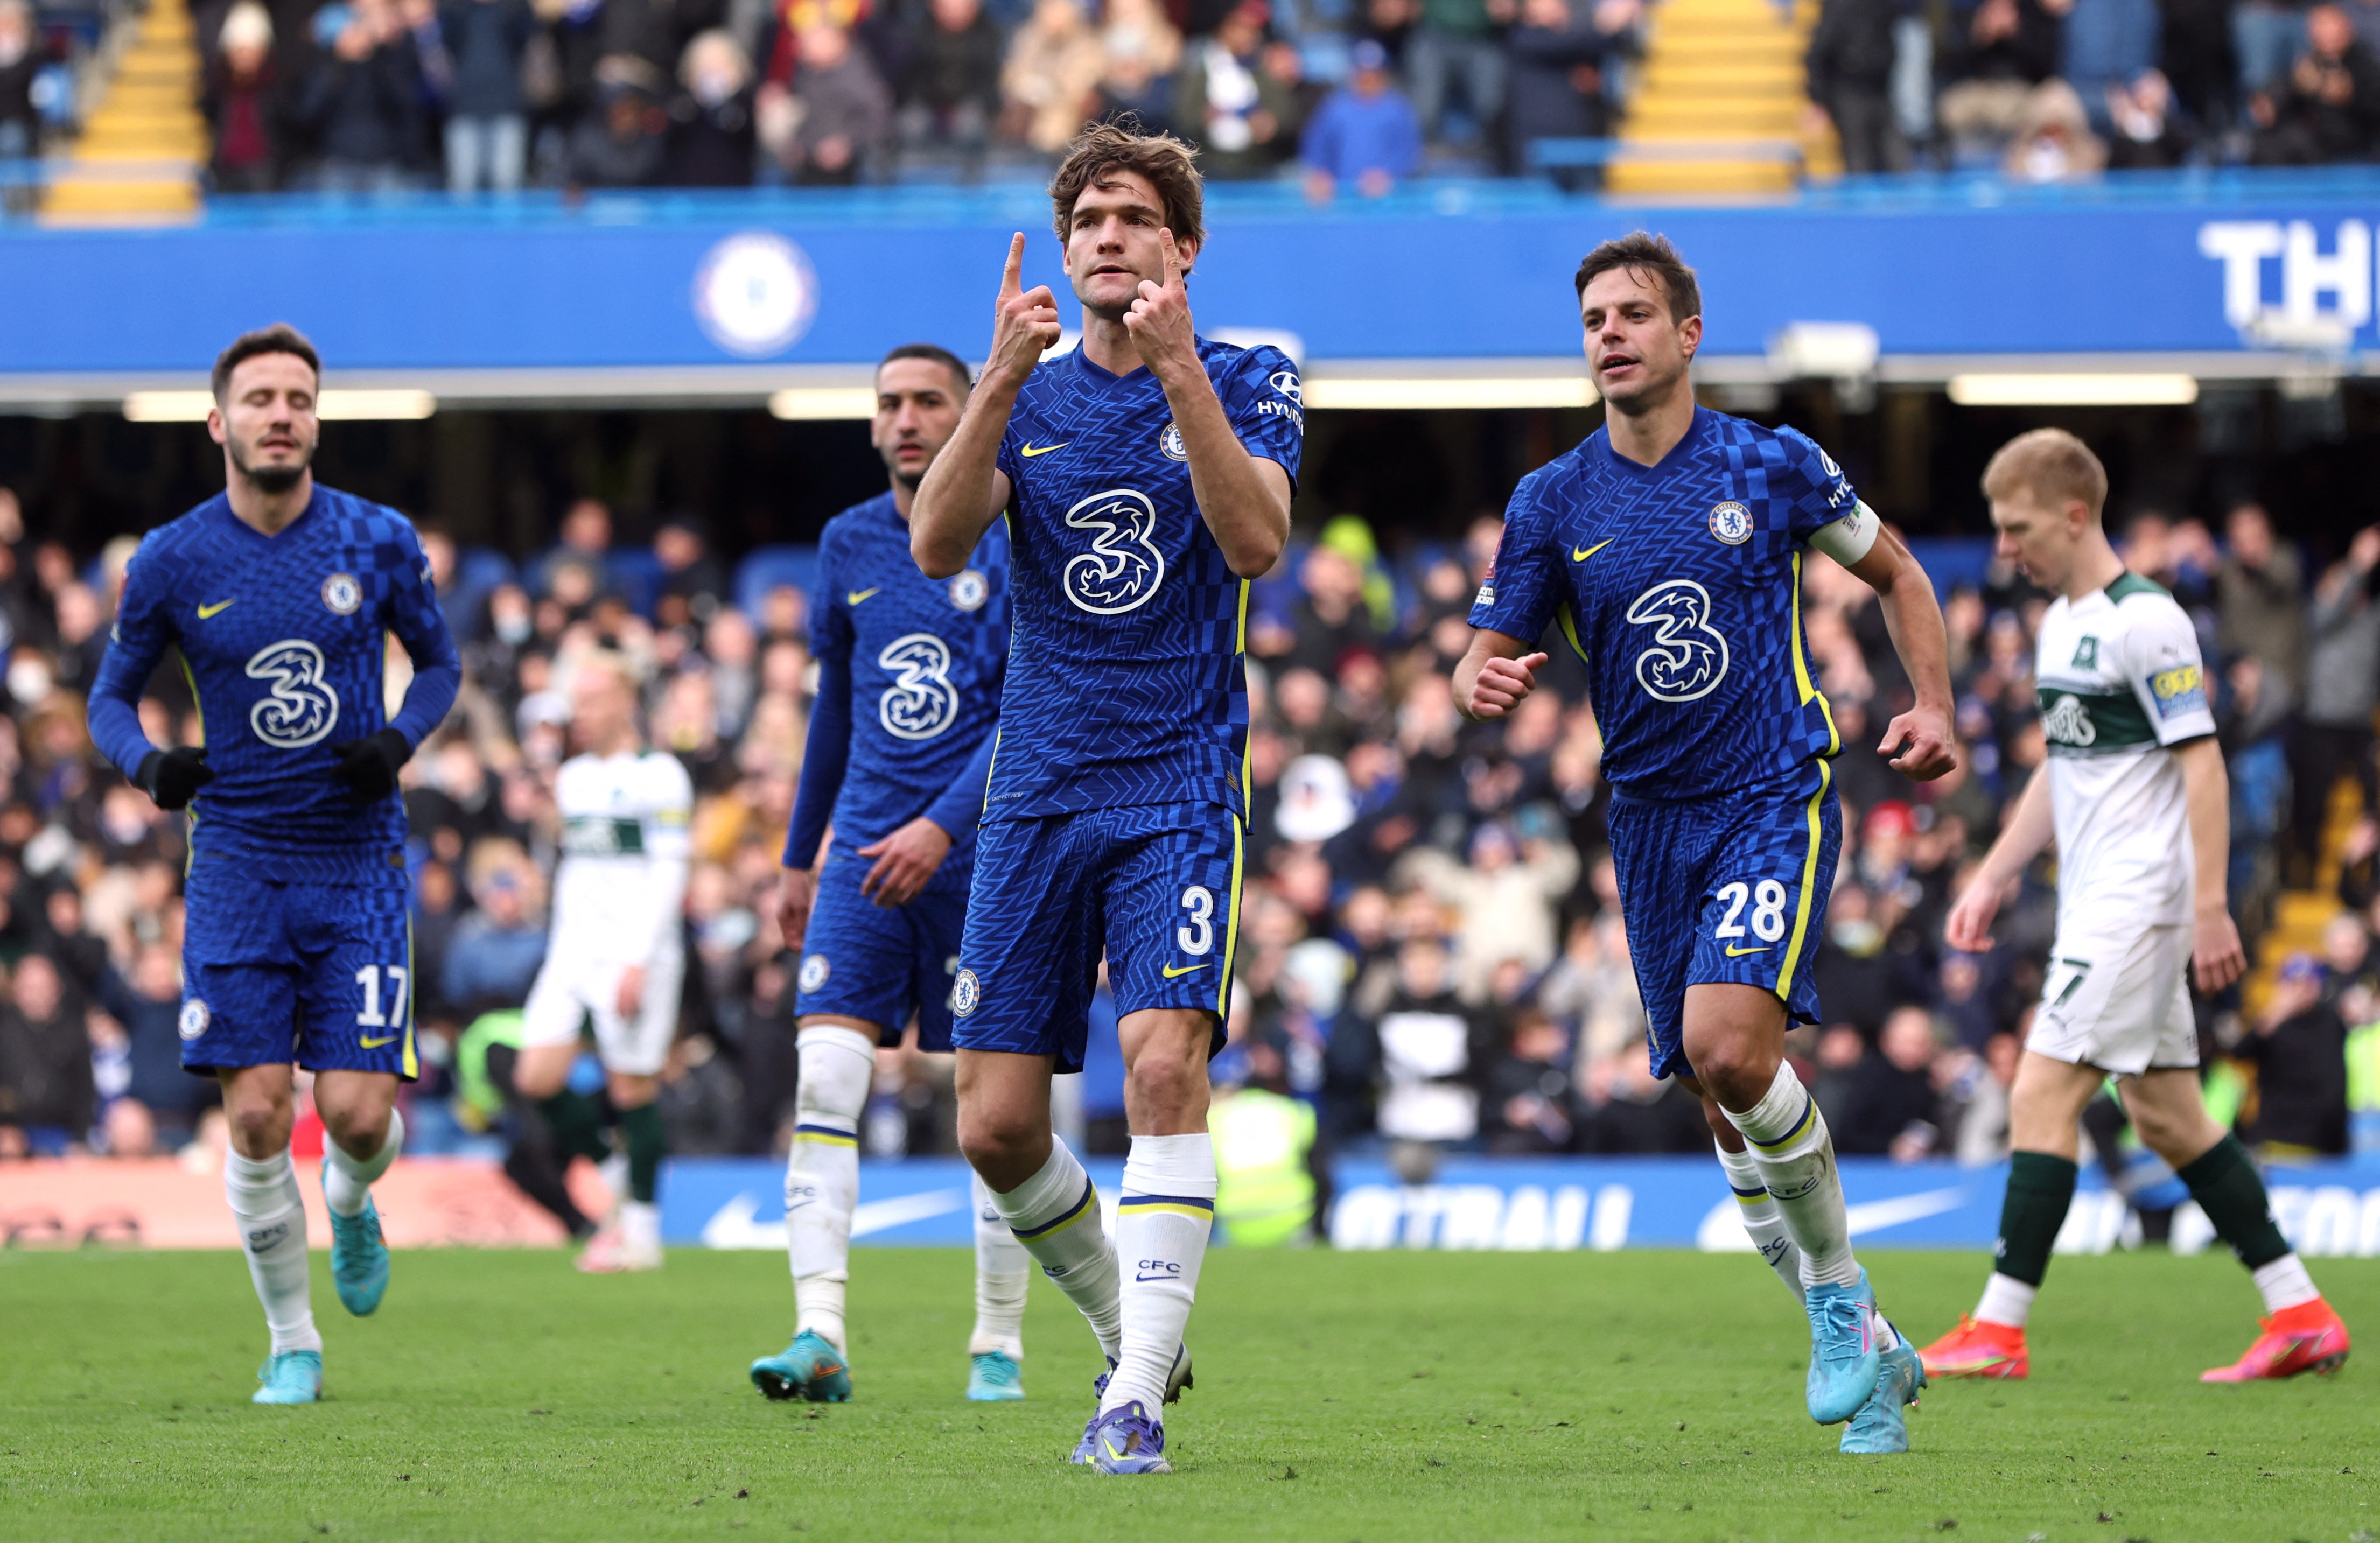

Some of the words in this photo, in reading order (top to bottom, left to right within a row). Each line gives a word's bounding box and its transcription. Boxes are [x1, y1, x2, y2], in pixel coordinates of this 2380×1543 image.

[2198, 221, 2380, 329] TH
[1715, 503, 1744, 514] CHELSEA
[1178, 886, 1213, 956] 3
[1715, 879, 1786, 942] 28
[355, 964, 407, 1029] 17
[1139, 1260, 1181, 1273] CFC
